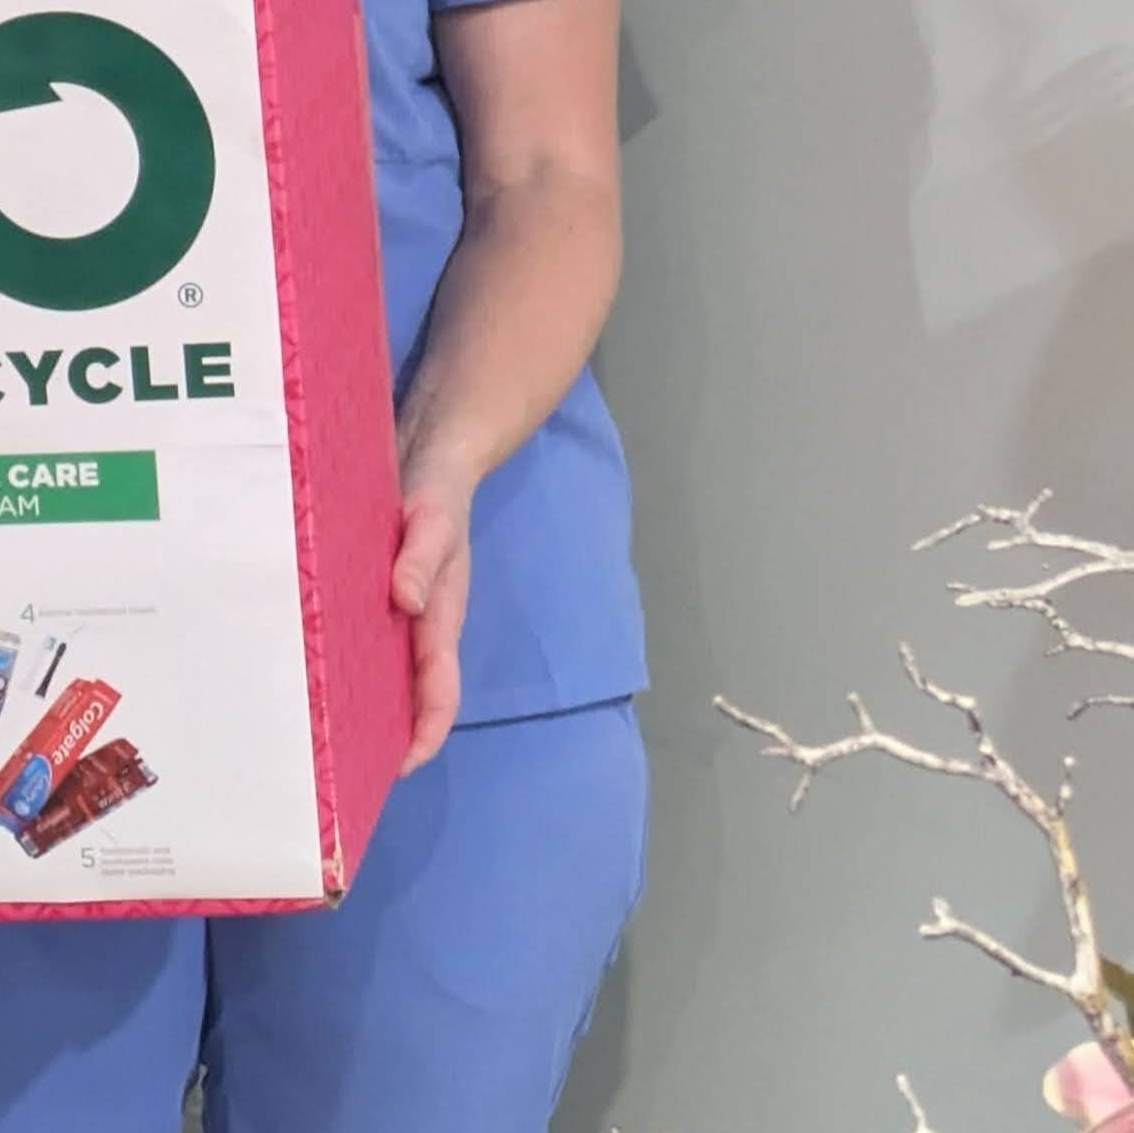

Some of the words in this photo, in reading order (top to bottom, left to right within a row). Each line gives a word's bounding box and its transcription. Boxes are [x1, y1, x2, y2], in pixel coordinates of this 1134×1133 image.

[7, 462, 100, 488] CARE
[20, 603, 35, 624] 4
[51, 700, 105, 765] Colgate
[81, 846, 95, 868] 5
